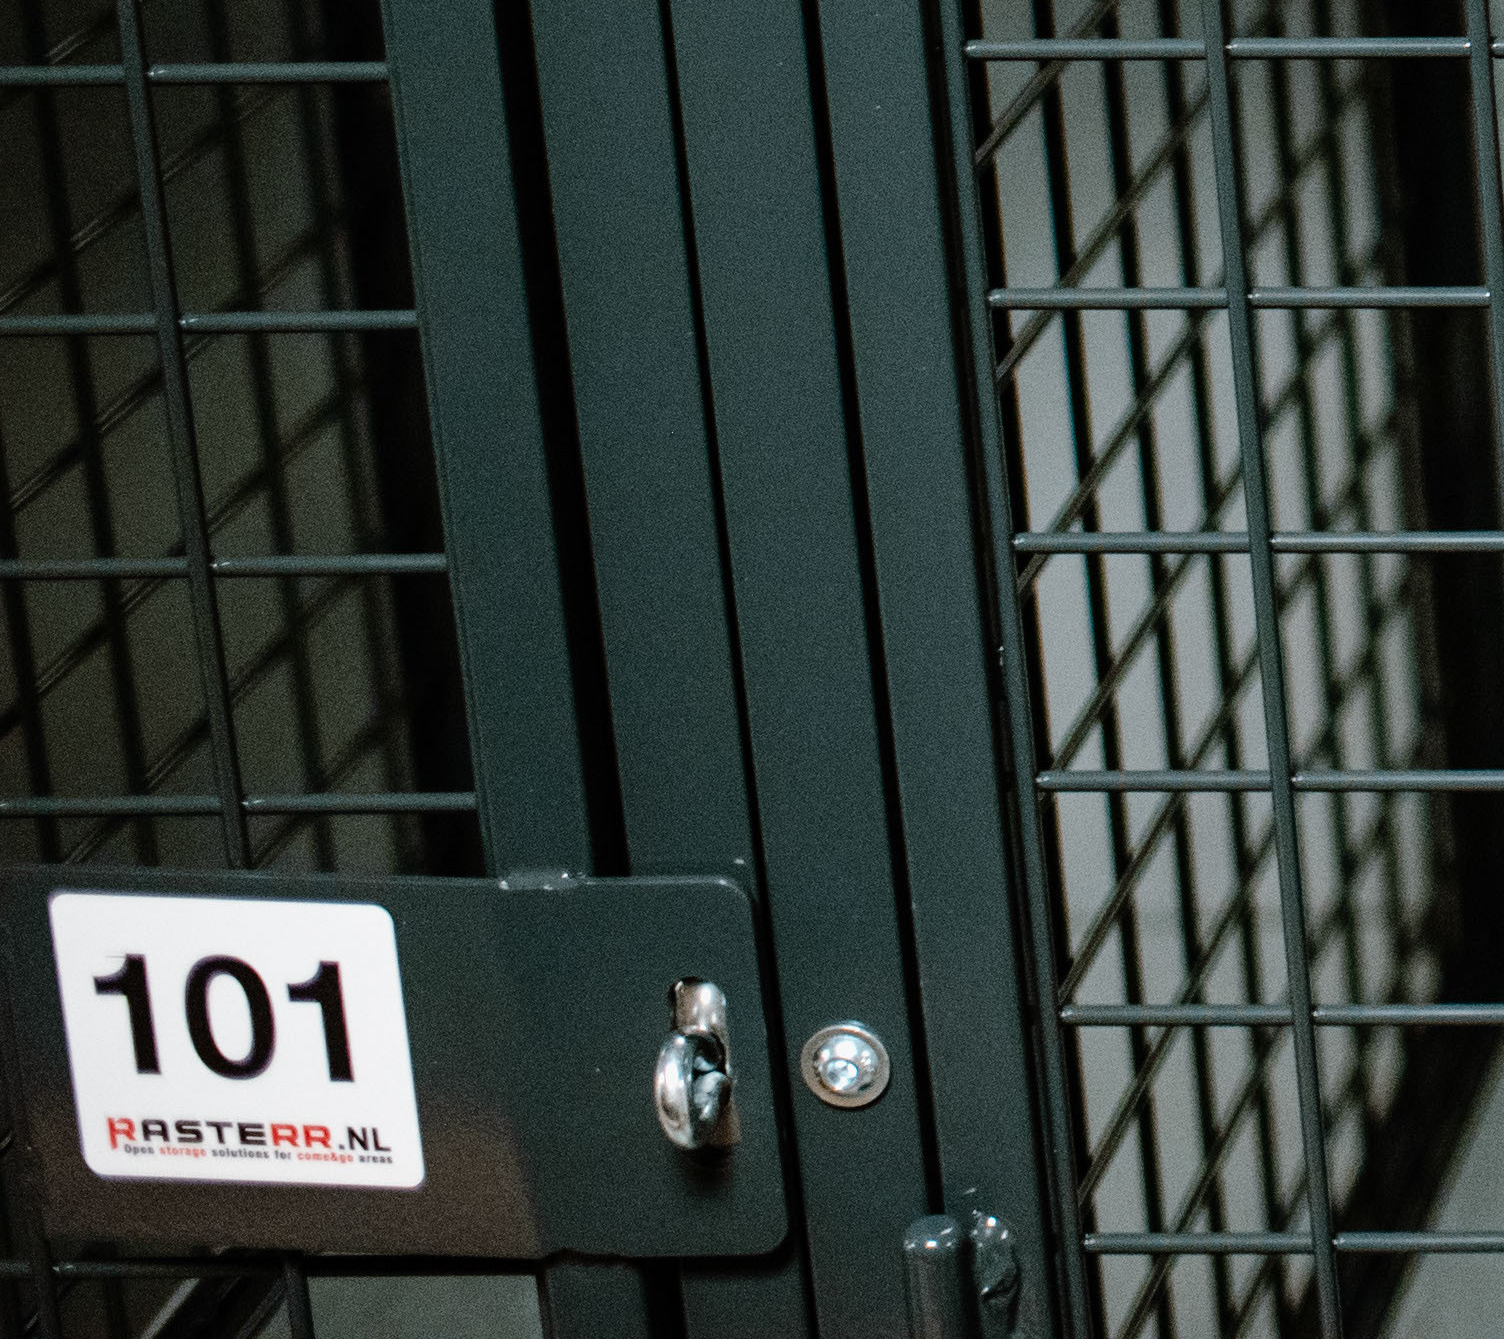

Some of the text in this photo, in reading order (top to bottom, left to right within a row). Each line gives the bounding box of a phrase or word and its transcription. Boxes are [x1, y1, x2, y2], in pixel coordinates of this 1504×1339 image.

[92, 952, 356, 1083] 101
[106, 1116, 392, 1153] RASTERR.NL
[124, 1143, 155, 1156] Open
